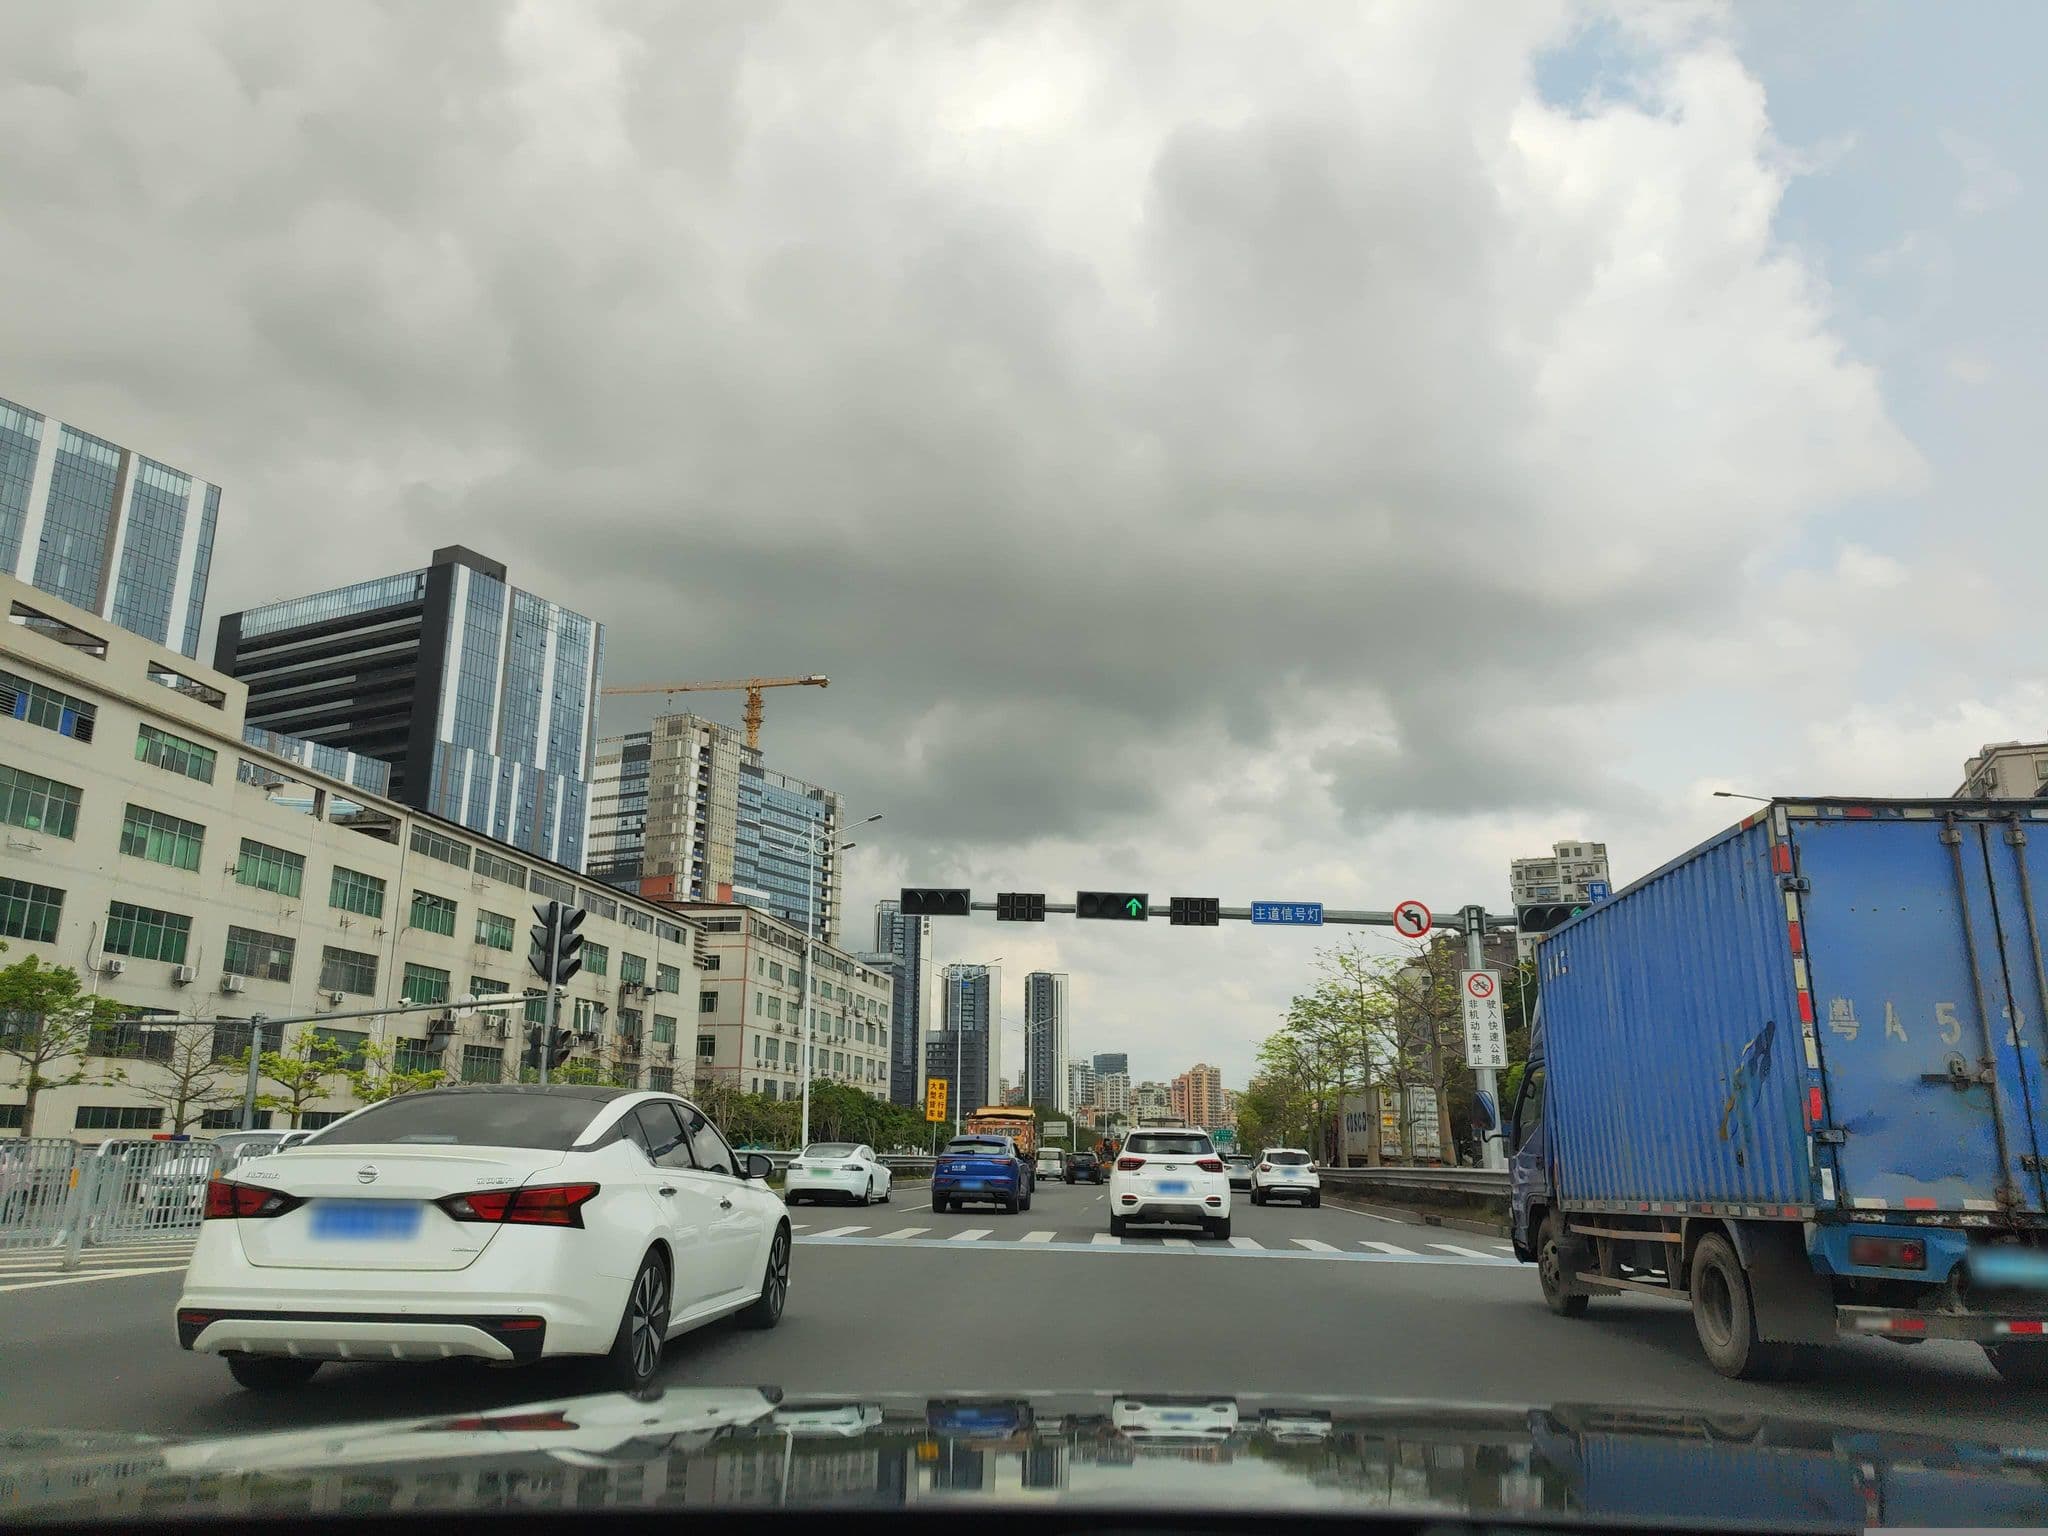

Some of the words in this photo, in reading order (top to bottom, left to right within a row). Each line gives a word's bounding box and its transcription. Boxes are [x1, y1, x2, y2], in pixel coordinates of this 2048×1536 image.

[1255, 906, 1320, 922] 主道信号灯
[1468, 999, 1484, 1065] 非机动车禁止
[1486, 999, 1502, 1065] 驶入快速公路
[929, 1082, 937, 1117] 大型货车
